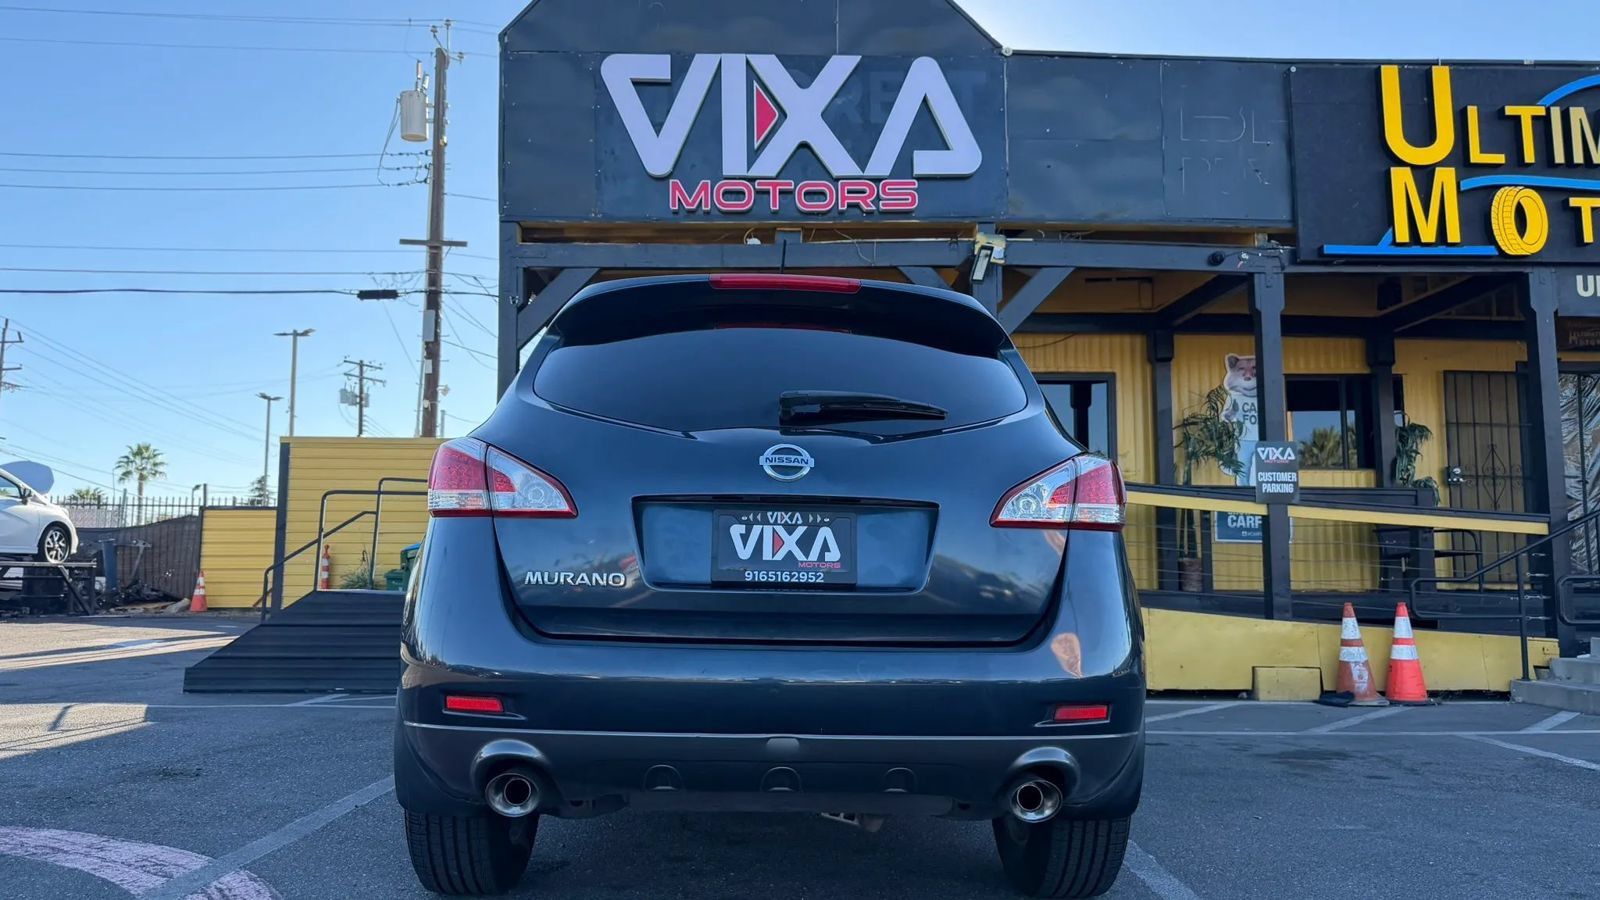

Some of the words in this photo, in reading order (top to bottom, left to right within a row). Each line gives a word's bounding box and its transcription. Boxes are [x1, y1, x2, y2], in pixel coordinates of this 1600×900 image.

[601, 53, 982, 177] VIXA
[669, 179, 918, 212] MOTORS
[1576, 275, 1600, 297] U
[1257, 447, 1296, 460] VIXA
[765, 457, 809, 465] NISSAN
[1258, 472, 1297, 482] CUSTOMER
[1262, 483, 1294, 494] PARKING
[767, 511, 802, 524] VIXA
[730, 524, 841, 562] VIXA
[525, 571, 626, 587] MURANO
[745, 571, 824, 582] 9165162952
